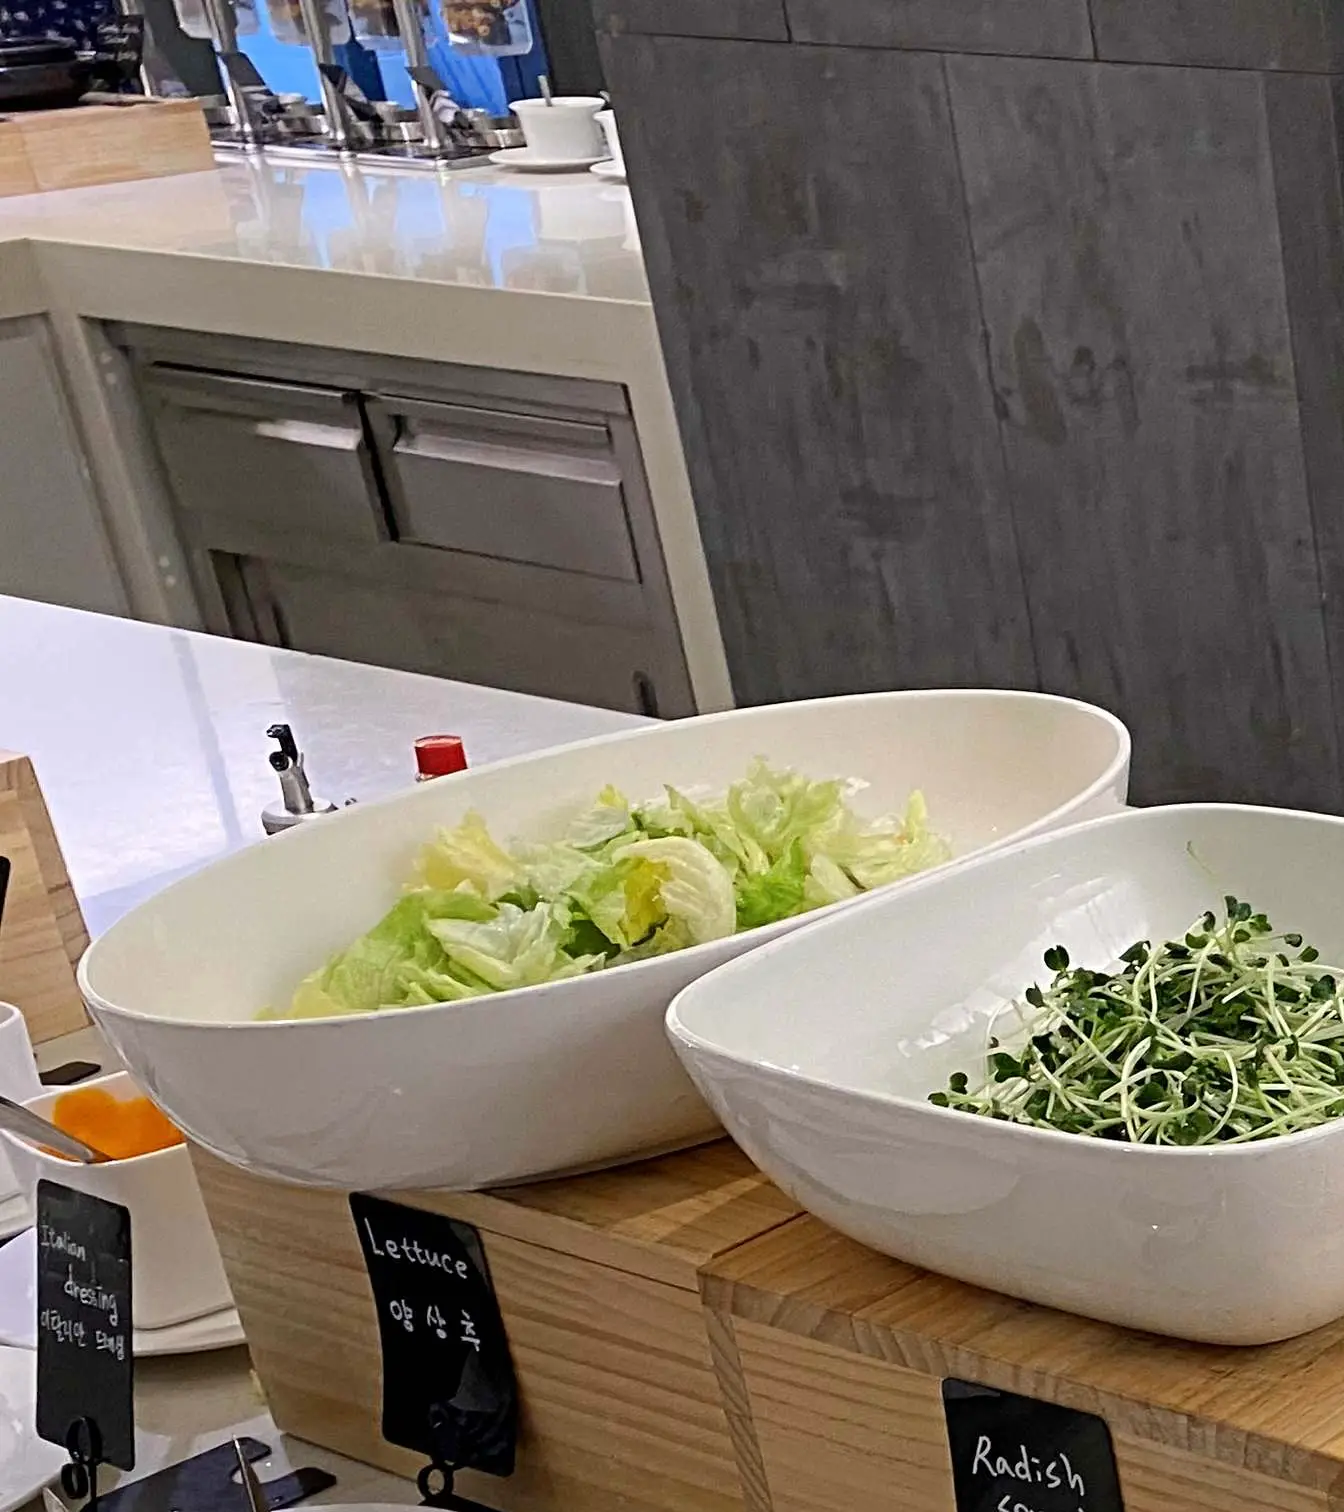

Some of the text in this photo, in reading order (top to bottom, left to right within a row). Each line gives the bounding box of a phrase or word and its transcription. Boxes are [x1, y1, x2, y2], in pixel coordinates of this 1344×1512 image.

[40, 1224, 87, 1263] Italian
[364, 1217, 469, 1280] Lettuce
[972, 1435, 1085, 1497] Radish
